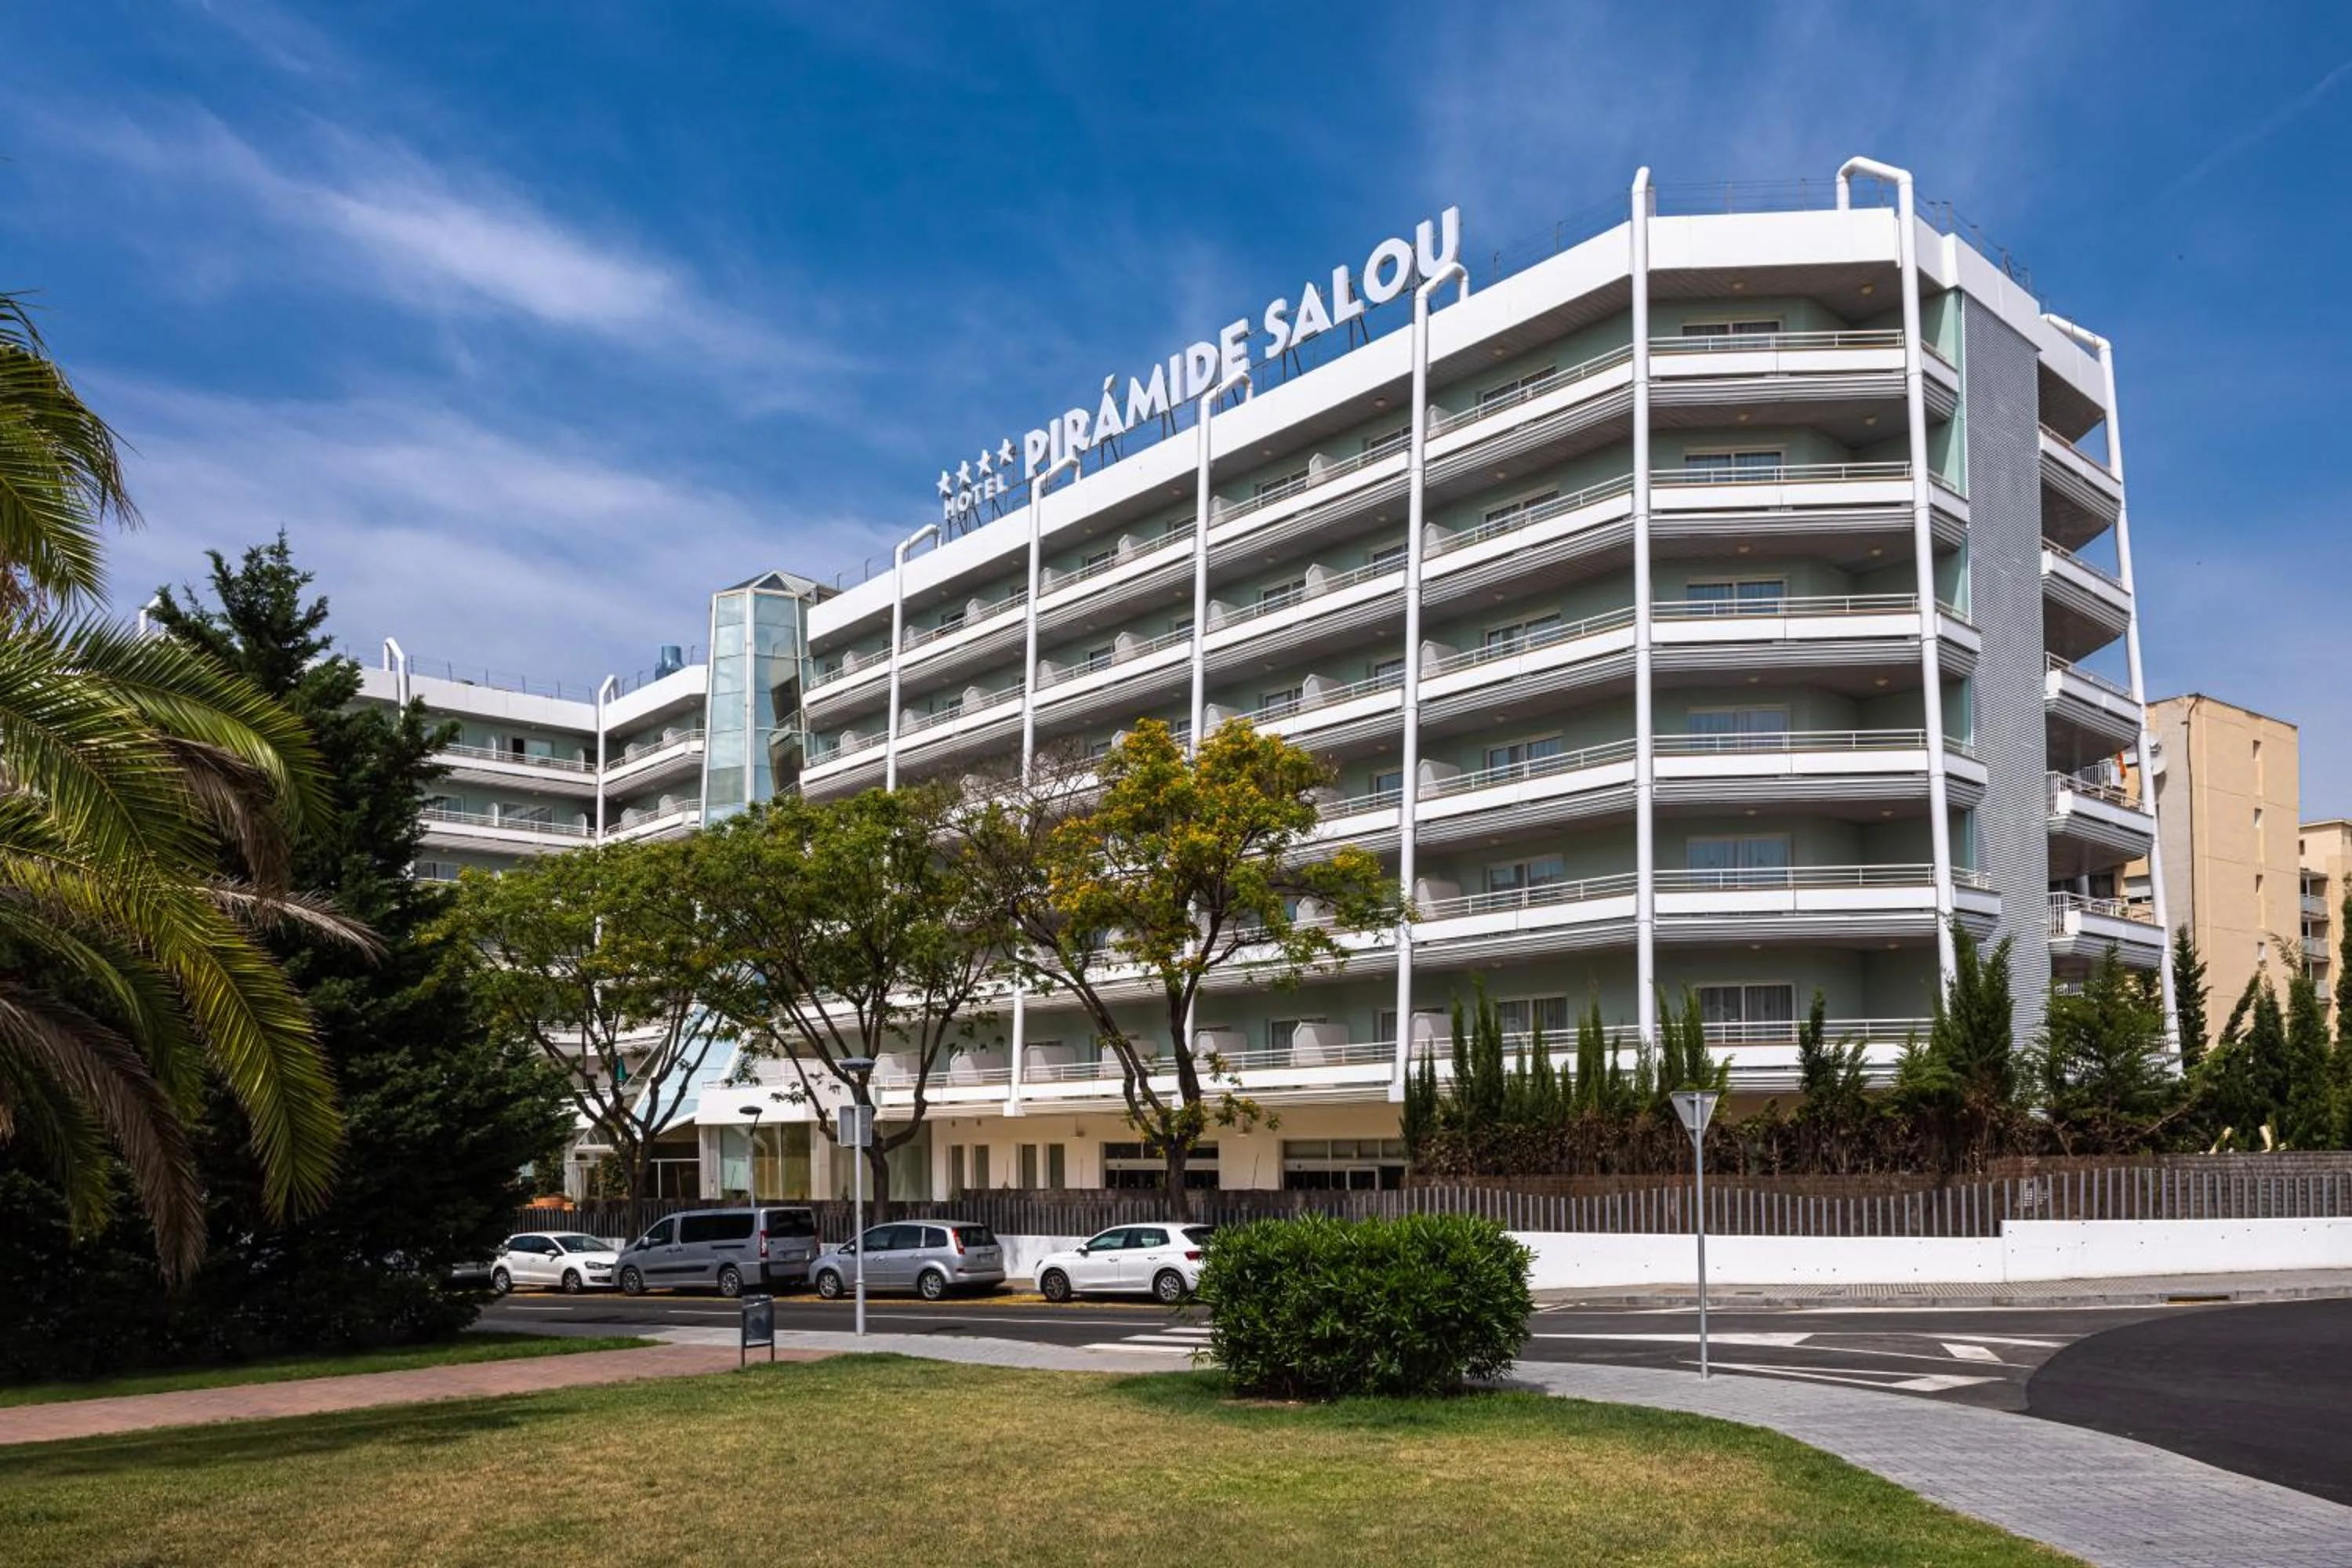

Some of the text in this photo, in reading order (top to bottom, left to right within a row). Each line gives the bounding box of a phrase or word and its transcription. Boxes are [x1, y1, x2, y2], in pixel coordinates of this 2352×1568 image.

[1024, 205, 1460, 480] PIRÁMIDE SALOU
[944, 473, 1009, 520] HOTEL
